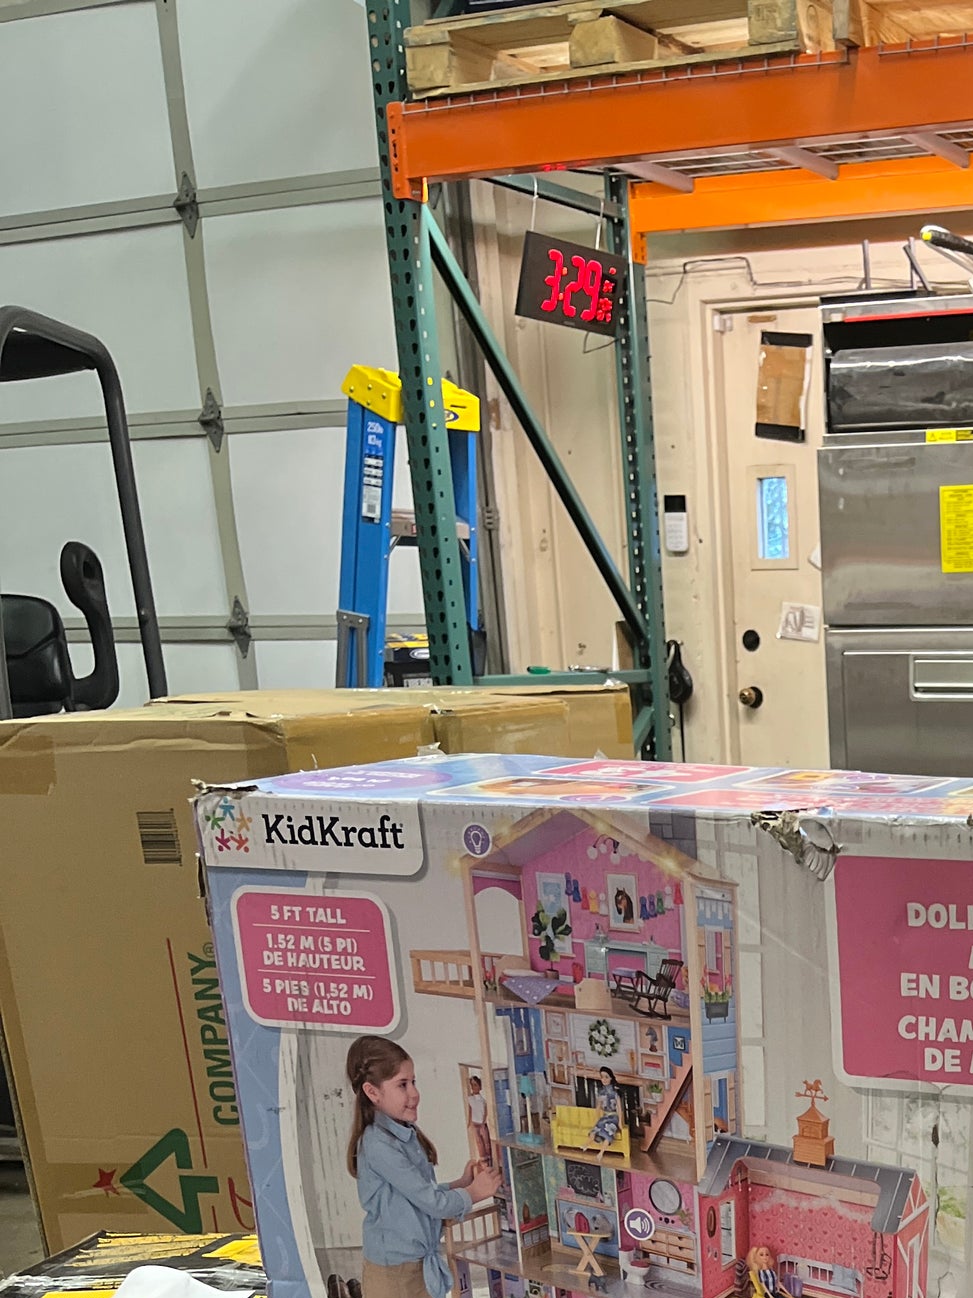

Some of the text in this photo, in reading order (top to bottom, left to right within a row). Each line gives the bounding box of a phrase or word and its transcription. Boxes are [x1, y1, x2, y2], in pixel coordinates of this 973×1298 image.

[262, 813, 405, 850] KidKraft
[270, 905, 347, 924] 5 FT TALL
[266, 933, 358, 954] 1.52 M (5 PI)
[263, 950, 366, 972] DE HAUTEUR
[262, 978, 374, 1001] 5 PIES (1,52 M)
[901, 972, 941, 999] EN
[287, 997, 352, 1016] DE ALTO
[923, 1047, 962, 1074] DE
